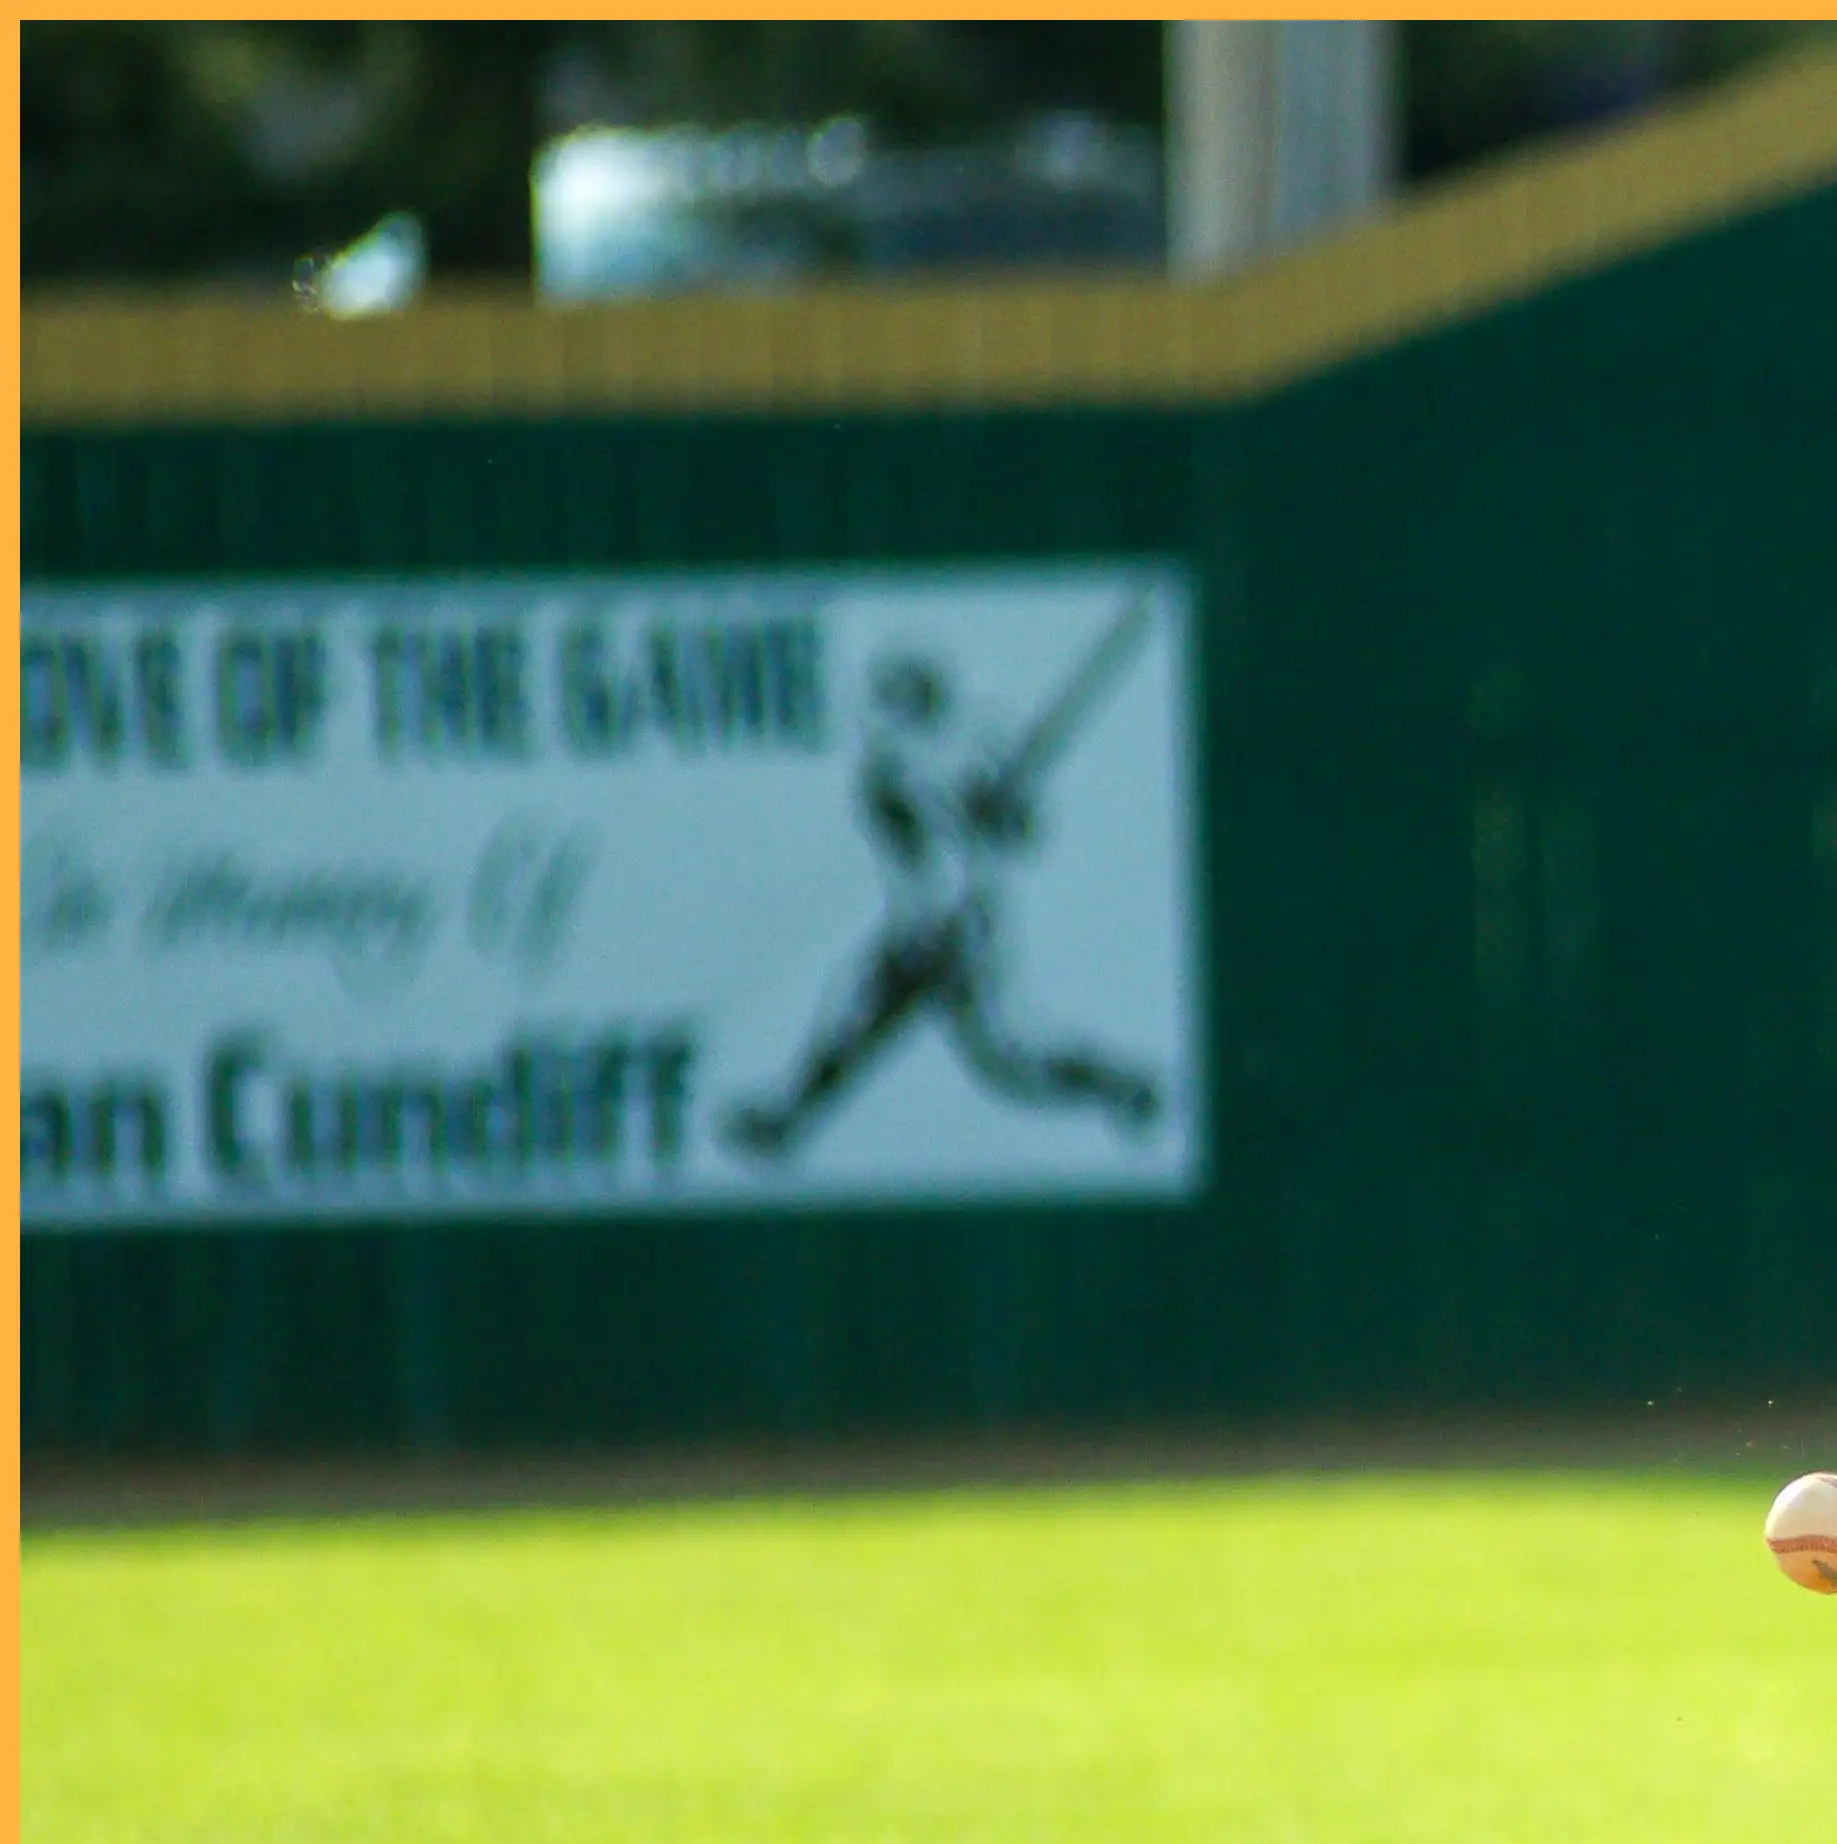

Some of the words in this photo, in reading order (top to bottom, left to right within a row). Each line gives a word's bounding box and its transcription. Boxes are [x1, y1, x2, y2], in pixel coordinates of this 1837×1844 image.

[212, 625, 326, 768] OF
[372, 624, 532, 762] THE
[561, 617, 827, 758] GAME
[208, 1020, 700, 1188] Cundiff
